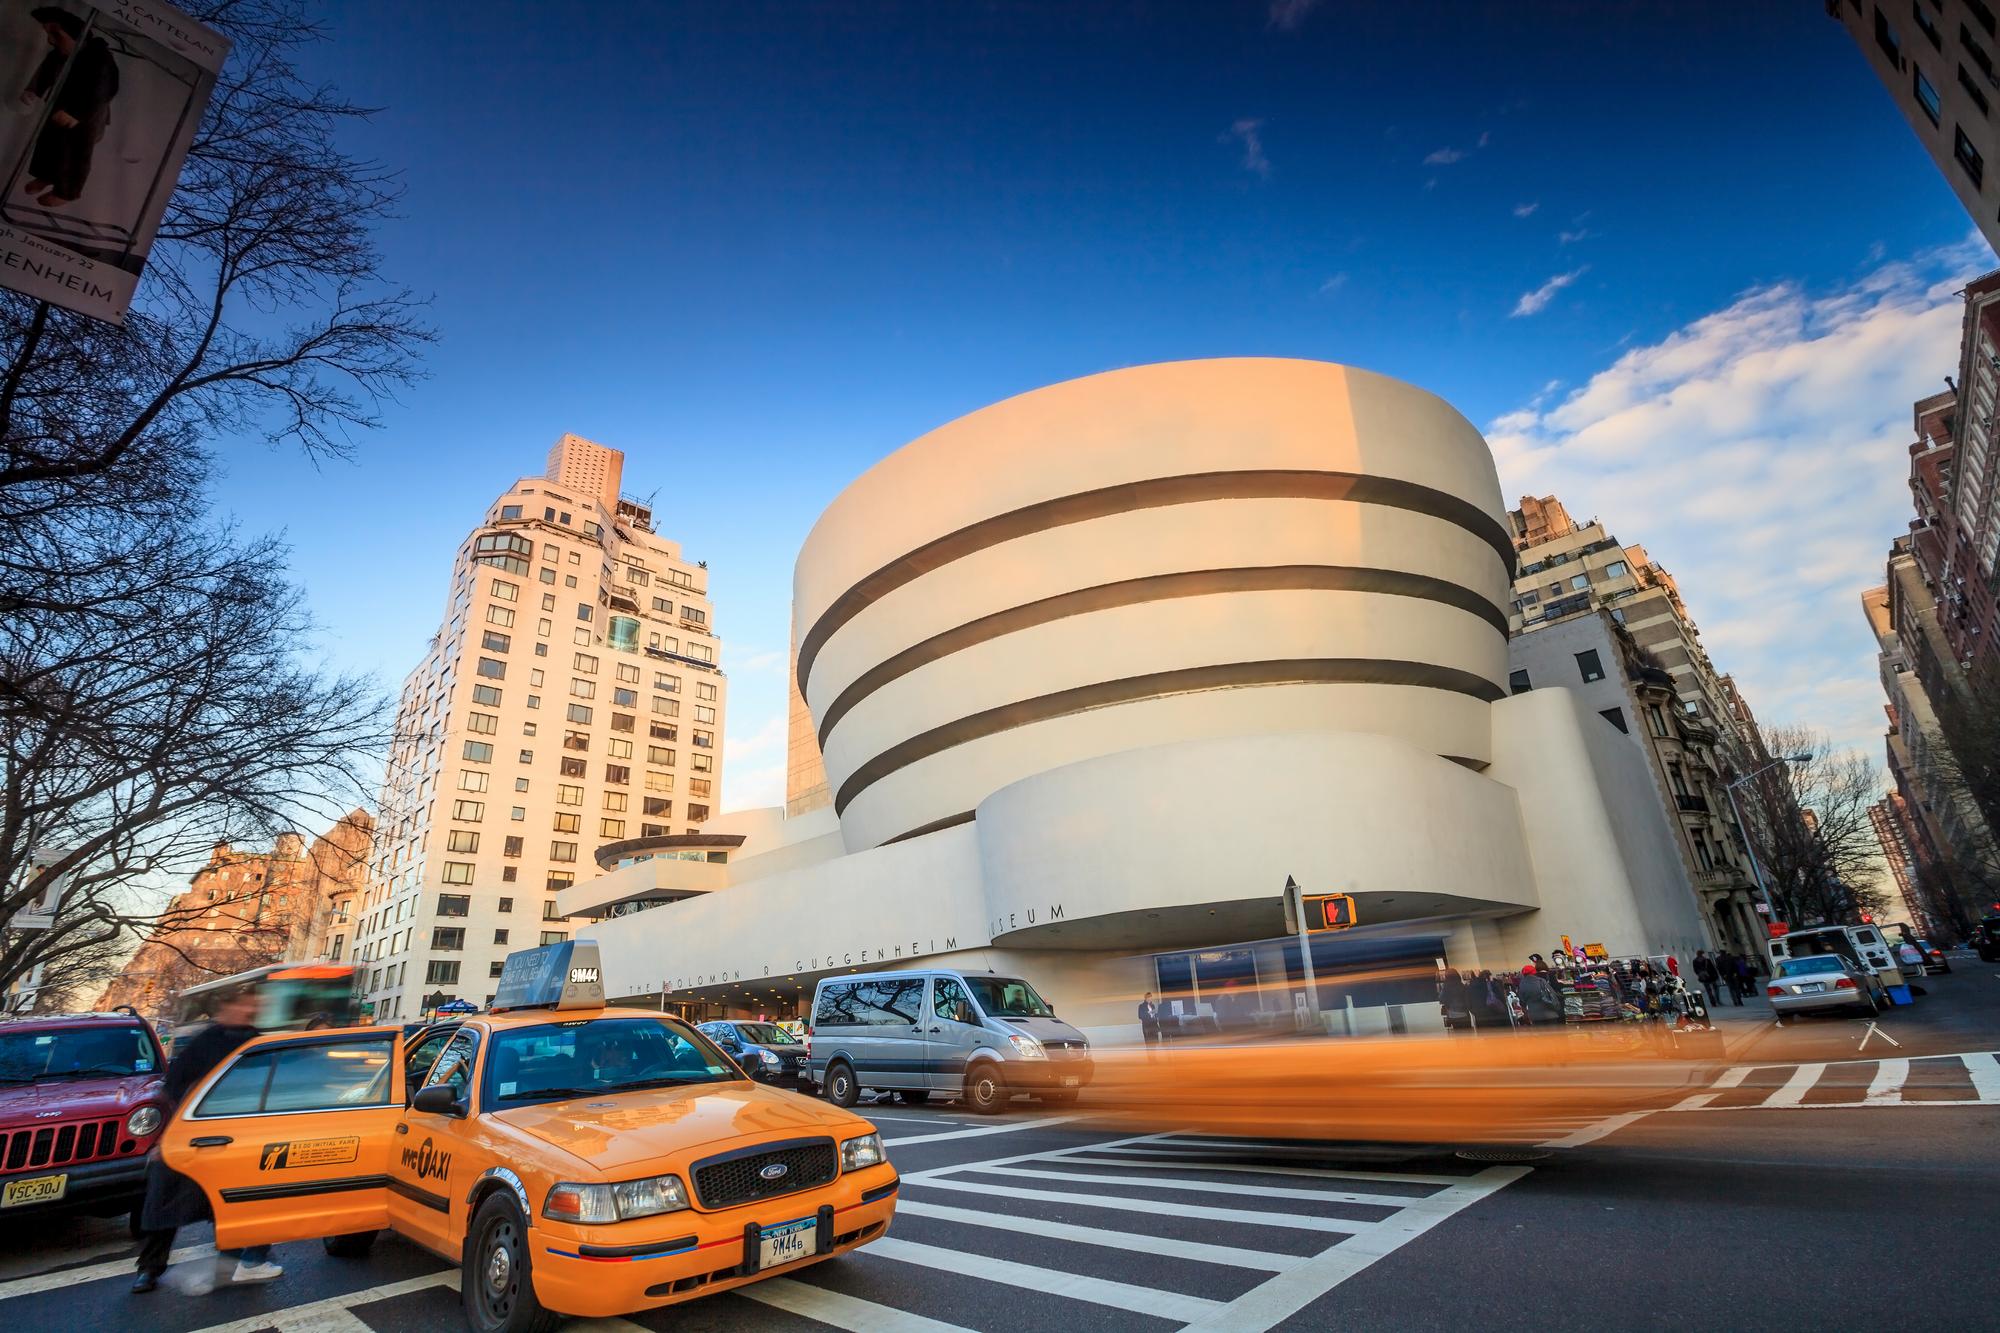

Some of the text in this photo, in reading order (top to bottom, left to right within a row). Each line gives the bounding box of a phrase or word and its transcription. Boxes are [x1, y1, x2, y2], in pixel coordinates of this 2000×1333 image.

[112, 9, 142, 28] ALL
[133, 6, 214, 56] CATTELAN
[20, 235, 76, 262] January
[78, 258, 95, 270] 22
[0, 249, 113, 303] ENHEIM
[571, 968, 598, 983] 9M44
[629, 983, 650, 995] THE
[664, 970, 741, 992] OLOMON
[796, 937, 957, 972] GUGGENHEIM
[401, 1146, 418, 1170] NYC
